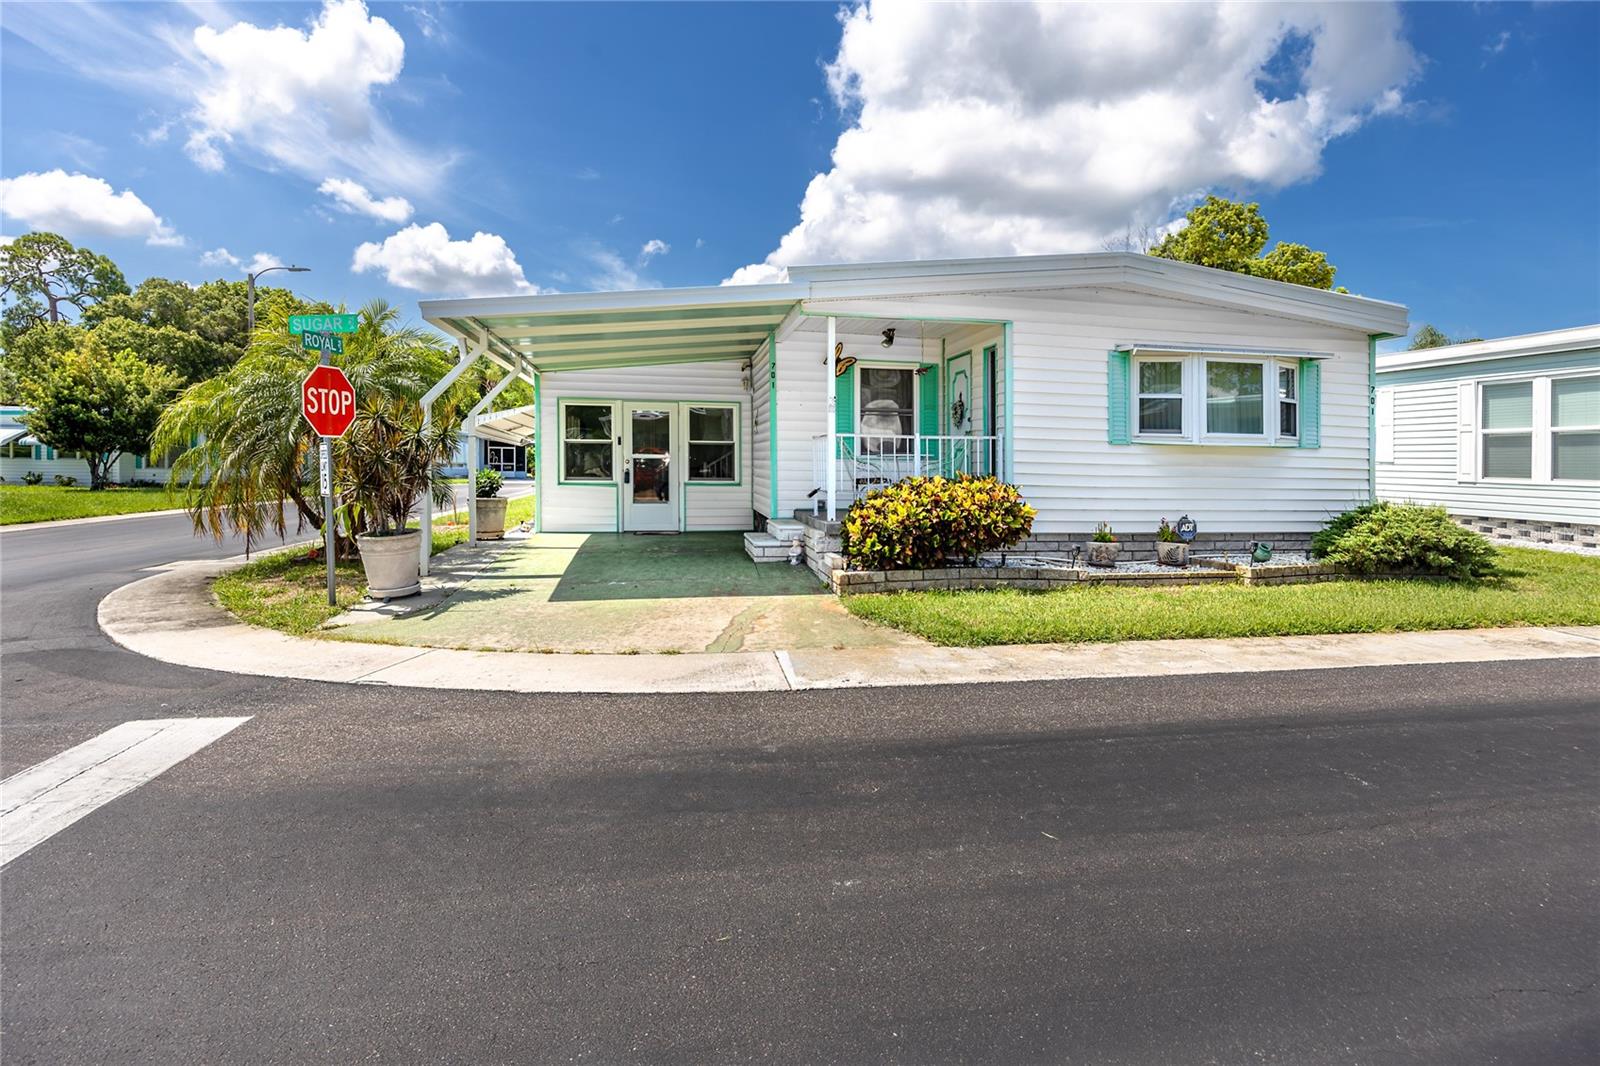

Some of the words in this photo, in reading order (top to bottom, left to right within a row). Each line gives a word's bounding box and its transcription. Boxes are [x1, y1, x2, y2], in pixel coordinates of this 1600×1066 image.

[292, 317, 343, 331] SUGAR
[304, 333, 337, 351] ROYAL
[307, 387, 352, 416] STOP
[1181, 523, 1194, 532] ADT
